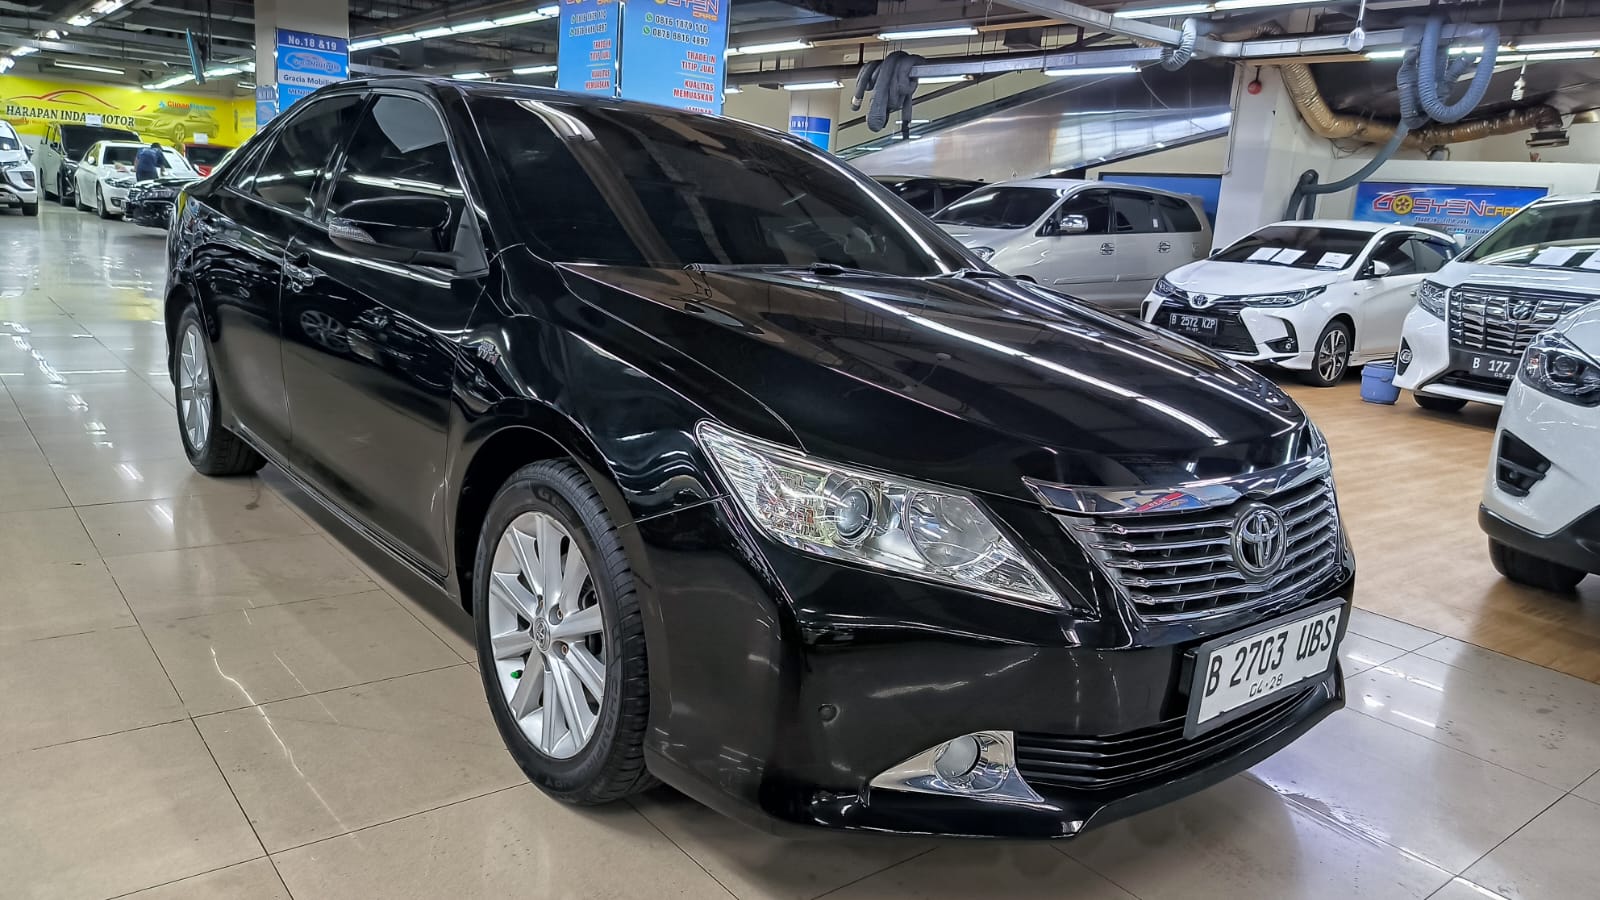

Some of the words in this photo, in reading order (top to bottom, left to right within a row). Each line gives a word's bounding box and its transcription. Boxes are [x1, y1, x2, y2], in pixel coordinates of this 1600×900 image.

[655, 15, 673, 25] 0816
[695, 23, 708, 33] 110
[288, 34, 315, 48] No.18
[687, 51, 707, 62] TRADE
[708, 55, 716, 63] IN
[681, 61, 697, 71] TITIP
[699, 65, 715, 74] JUAL
[283, 74, 306, 83] Gracia
[684, 79, 714, 91] KUALITAS
[673, 89, 714, 102] MEMUASKAN
[6, 105, 58, 120] HARAPAN
[60, 110, 95, 122] INDA
[1171, 314, 1177, 325] B
[1472, 357, 1481, 369] B
[1487, 359, 1511, 373] 177
[1204, 654, 1223, 698] B
[1229, 630, 1289, 688] 2703
[1295, 614, 1336, 662] UBS
